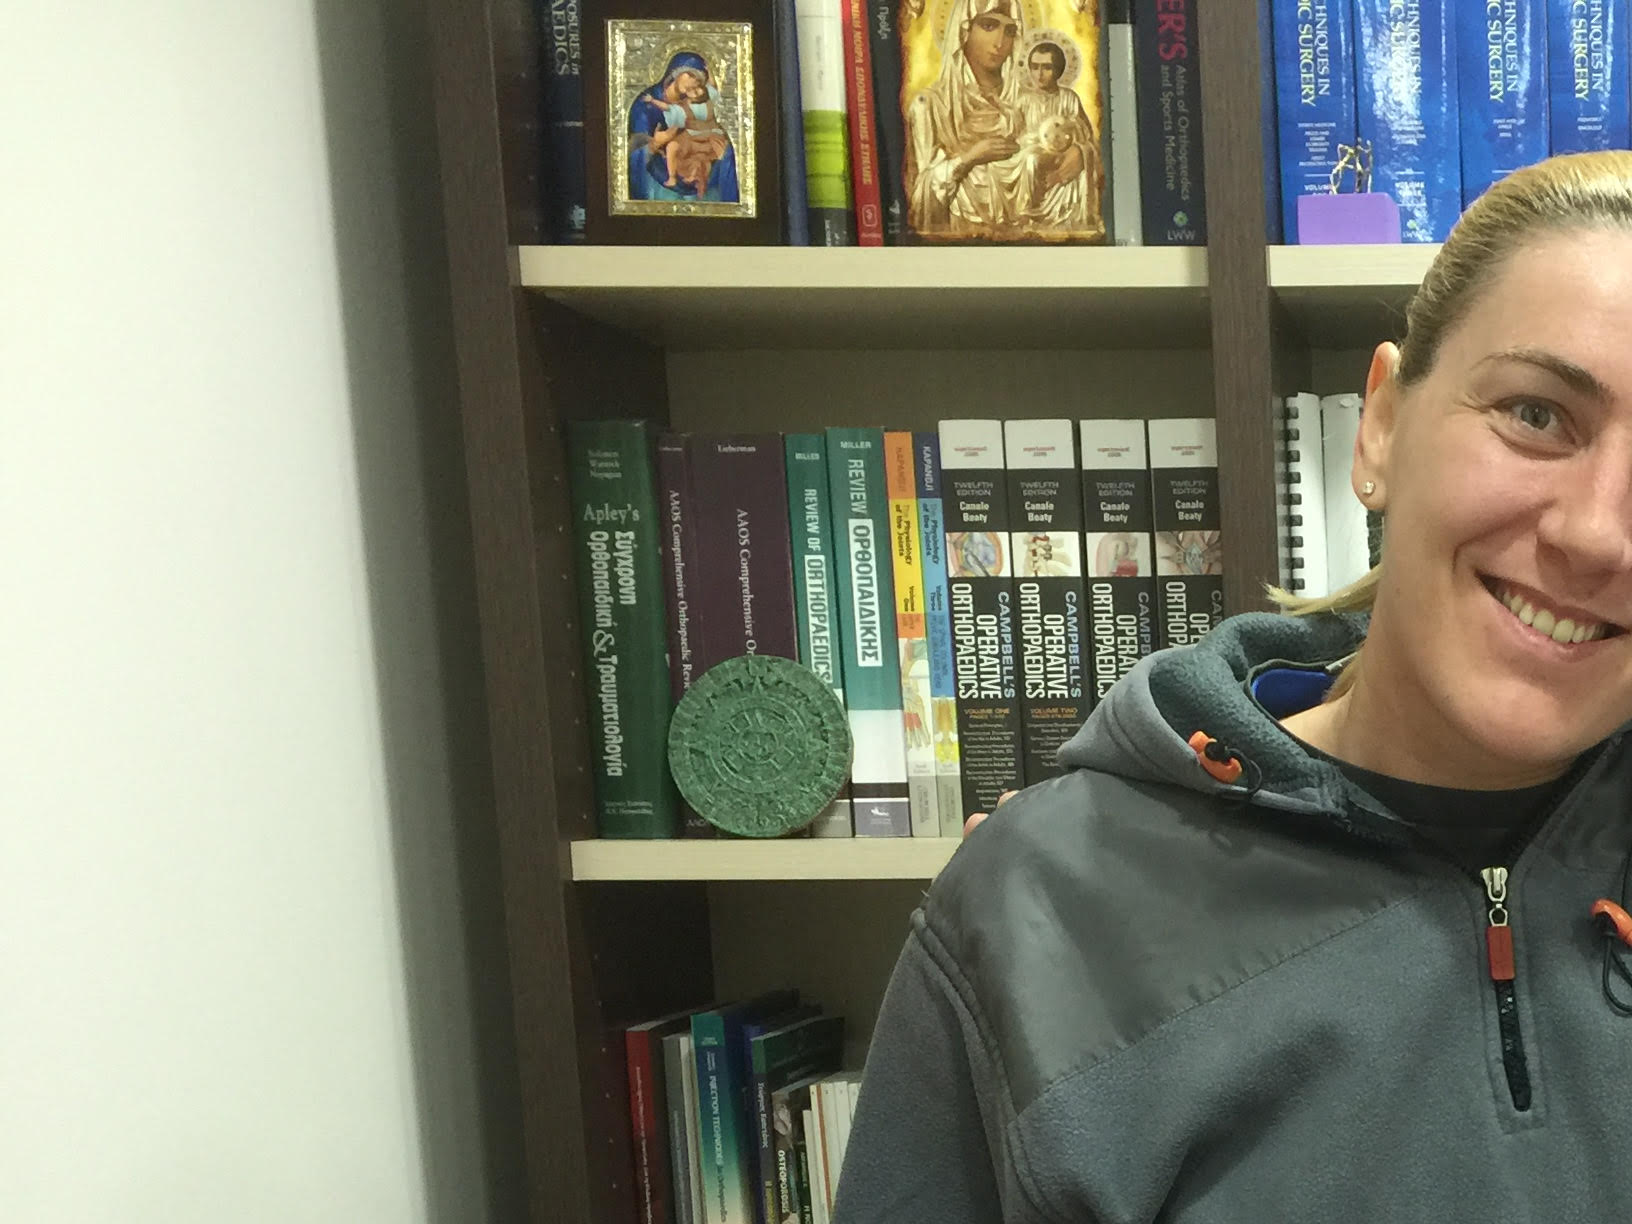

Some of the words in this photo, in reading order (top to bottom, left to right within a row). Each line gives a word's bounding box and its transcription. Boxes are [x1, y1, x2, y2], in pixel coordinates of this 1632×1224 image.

[1314, 0, 1331, 76] HNIQUES
[1297, 23, 1317, 107] SURGERY
[1487, 20, 1505, 104] SURGERY
[1572, 18, 1590, 102] SURGERY
[1160, 65, 1172, 88] and
[1176, 64, 1187, 97] Atlas
[1318, 79, 1331, 97] IN
[1506, 73, 1519, 93] IN
[1591, 73, 1605, 91] IN
[1161, 91, 1175, 131] Sports
[1177, 99, 1188, 113] of
[1165, 135, 1176, 191] Medicine
[1178, 115, 1193, 202] Orthopaedics
[1167, 230, 1196, 241] LWW
[840, 441, 872, 449] MILLER
[923, 445, 935, 492] KAPANDJI
[1170, 480, 1209, 488] TWELFTH
[848, 459, 867, 514] REVIEW
[954, 481, 994, 489] TWELFTH
[957, 488, 992, 497] EDITION
[1020, 481, 1060, 489] TWELFTH
[1022, 488, 1058, 497] EDITION
[1096, 482, 1136, 490] TWELFTH
[1098, 489, 1133, 497] EDITION
[1172, 487, 1207, 496] EDITION
[583, 502, 641, 525] Apley's
[669, 490, 682, 522] AAOS
[804, 488, 820, 534] REVIEW
[959, 501, 990, 511] Canale
[962, 512, 988, 523] Beaty
[1024, 501, 1055, 511] Canale
[1027, 512, 1053, 523] Beaty
[1100, 501, 1131, 511] Canale
[1103, 513, 1129, 524] Beaty
[1175, 499, 1205, 510] Canale
[1178, 511, 1203, 522] Beaty
[736, 508, 750, 547] AAOS
[807, 535, 821, 552] OF
[613, 530, 639, 606] Σύγχρονη
[672, 523, 686, 599] Comprehensive
[587, 530, 619, 628] Ορθοπαιδική
[739, 548, 755, 637] Comprehensive
[852, 524, 880, 662] ΟΡΘΟΠΑΙΔΙΚΗΣ
[678, 600, 692, 665] Orthopaedic
[807, 556, 832, 683] ORTHOPAEDICS
[592, 629, 616, 658] &
[951, 583, 979, 700] ORTHOPAEDICS
[998, 591, 1016, 699] CAMPBELL'S
[1019, 582, 1046, 699] ORTHOPAEDICS
[1043, 614, 1069, 699] OPERATIVE
[1065, 591, 1082, 698] CAMPBELL'S
[976, 614, 1002, 700] OPERATIVE
[597, 654, 629, 777] Τραυματιολογία
[777, 1149, 789, 1214] OSTEOPOROSIS
